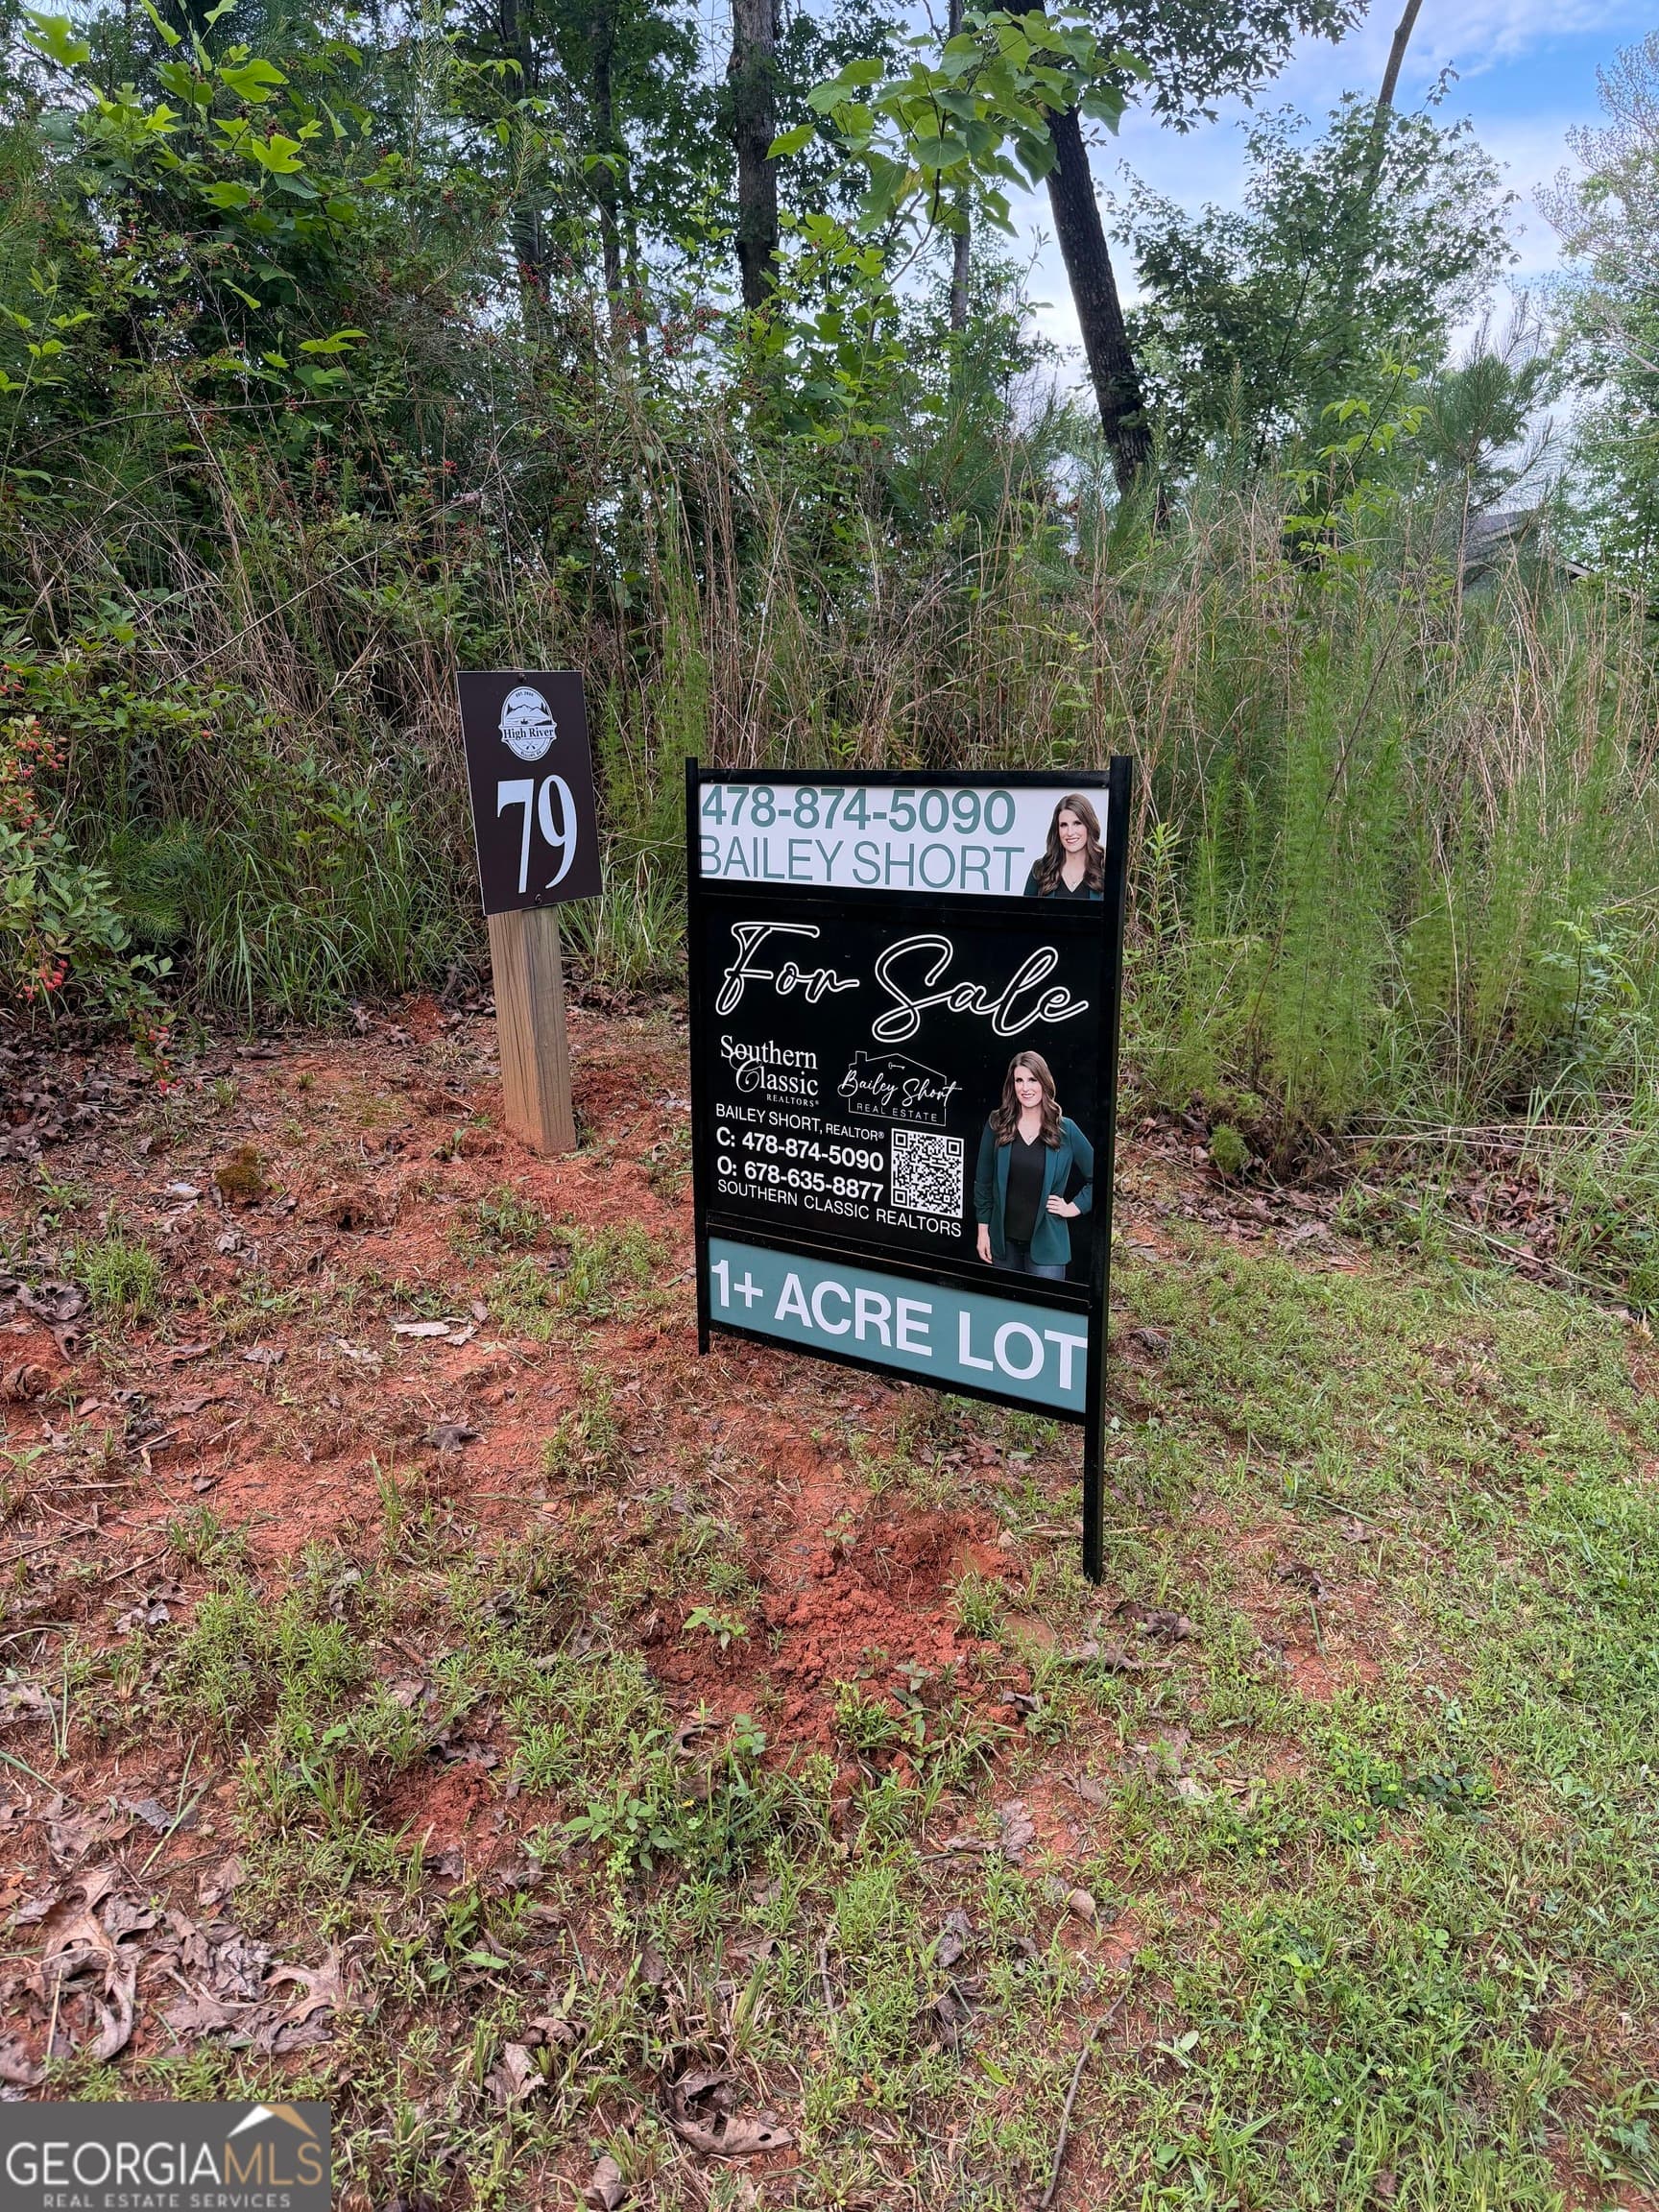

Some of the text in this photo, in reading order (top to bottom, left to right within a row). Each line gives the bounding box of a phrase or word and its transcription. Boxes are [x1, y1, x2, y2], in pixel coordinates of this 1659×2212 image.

[503, 727, 554, 741] High River
[702, 784, 1017, 835] 478-874-5090
[497, 774, 578, 894] 79
[699, 834, 1025, 892] BAILEY SHORT
[715, 922, 1090, 1044] For Sale
[720, 1035, 819, 1070] Southern
[730, 1059, 819, 1096] Classic
[837, 1070, 963, 1108] Bailey Short
[716, 1103, 766, 1124] BAILEY
[768, 1112, 823, 1135] SHORT,
[856, 1102, 938, 1122] REAL ESTATE
[715, 1126, 884, 1172] C: 478-874-5090
[716, 1155, 884, 1202] O: 678-635-8877
[717, 1179, 962, 1238] SOUTHERN CLASSIC REALTORS
[710, 1259, 1088, 1390] 1+ ACRE LOT
